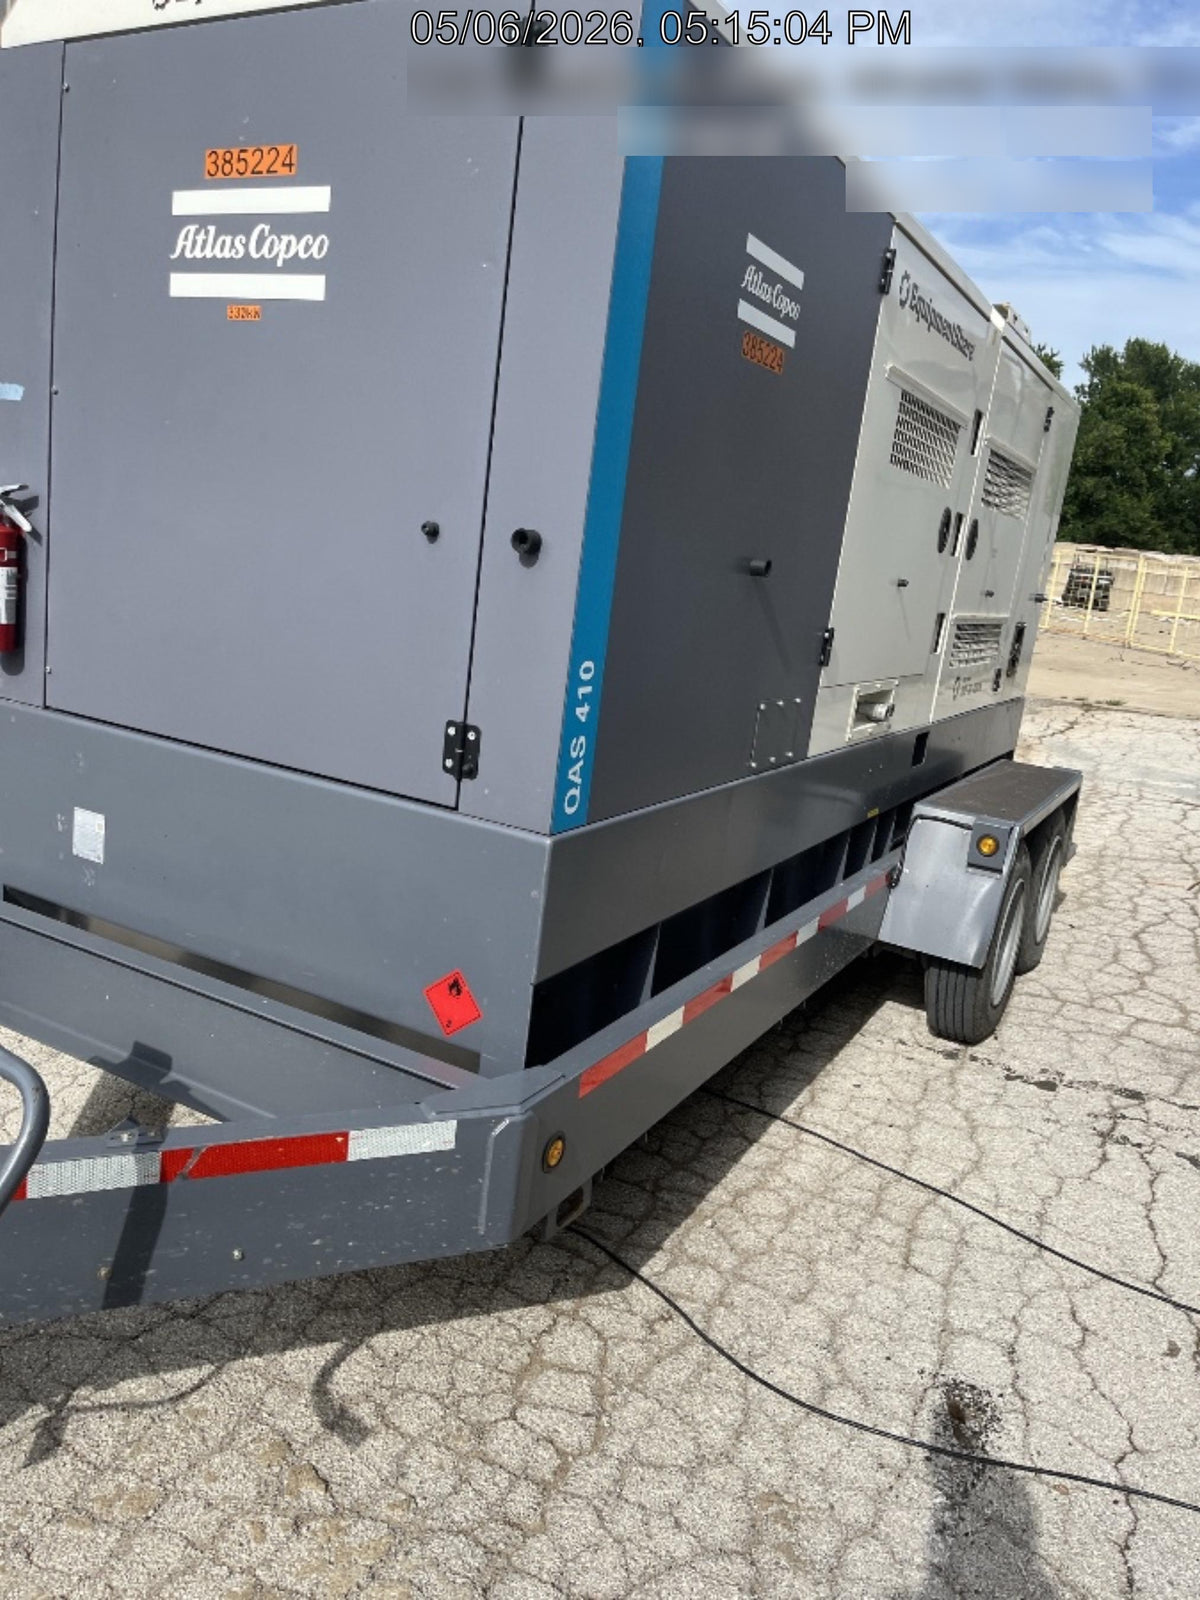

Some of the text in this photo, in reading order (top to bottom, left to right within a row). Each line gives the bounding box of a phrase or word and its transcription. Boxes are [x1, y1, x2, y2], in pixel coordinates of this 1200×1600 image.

[207, 145, 295, 177] 385224
[170, 223, 329, 268] Atlas Copco
[741, 264, 801, 321] Atlas Copco
[563, 660, 595, 815] QAS 410
